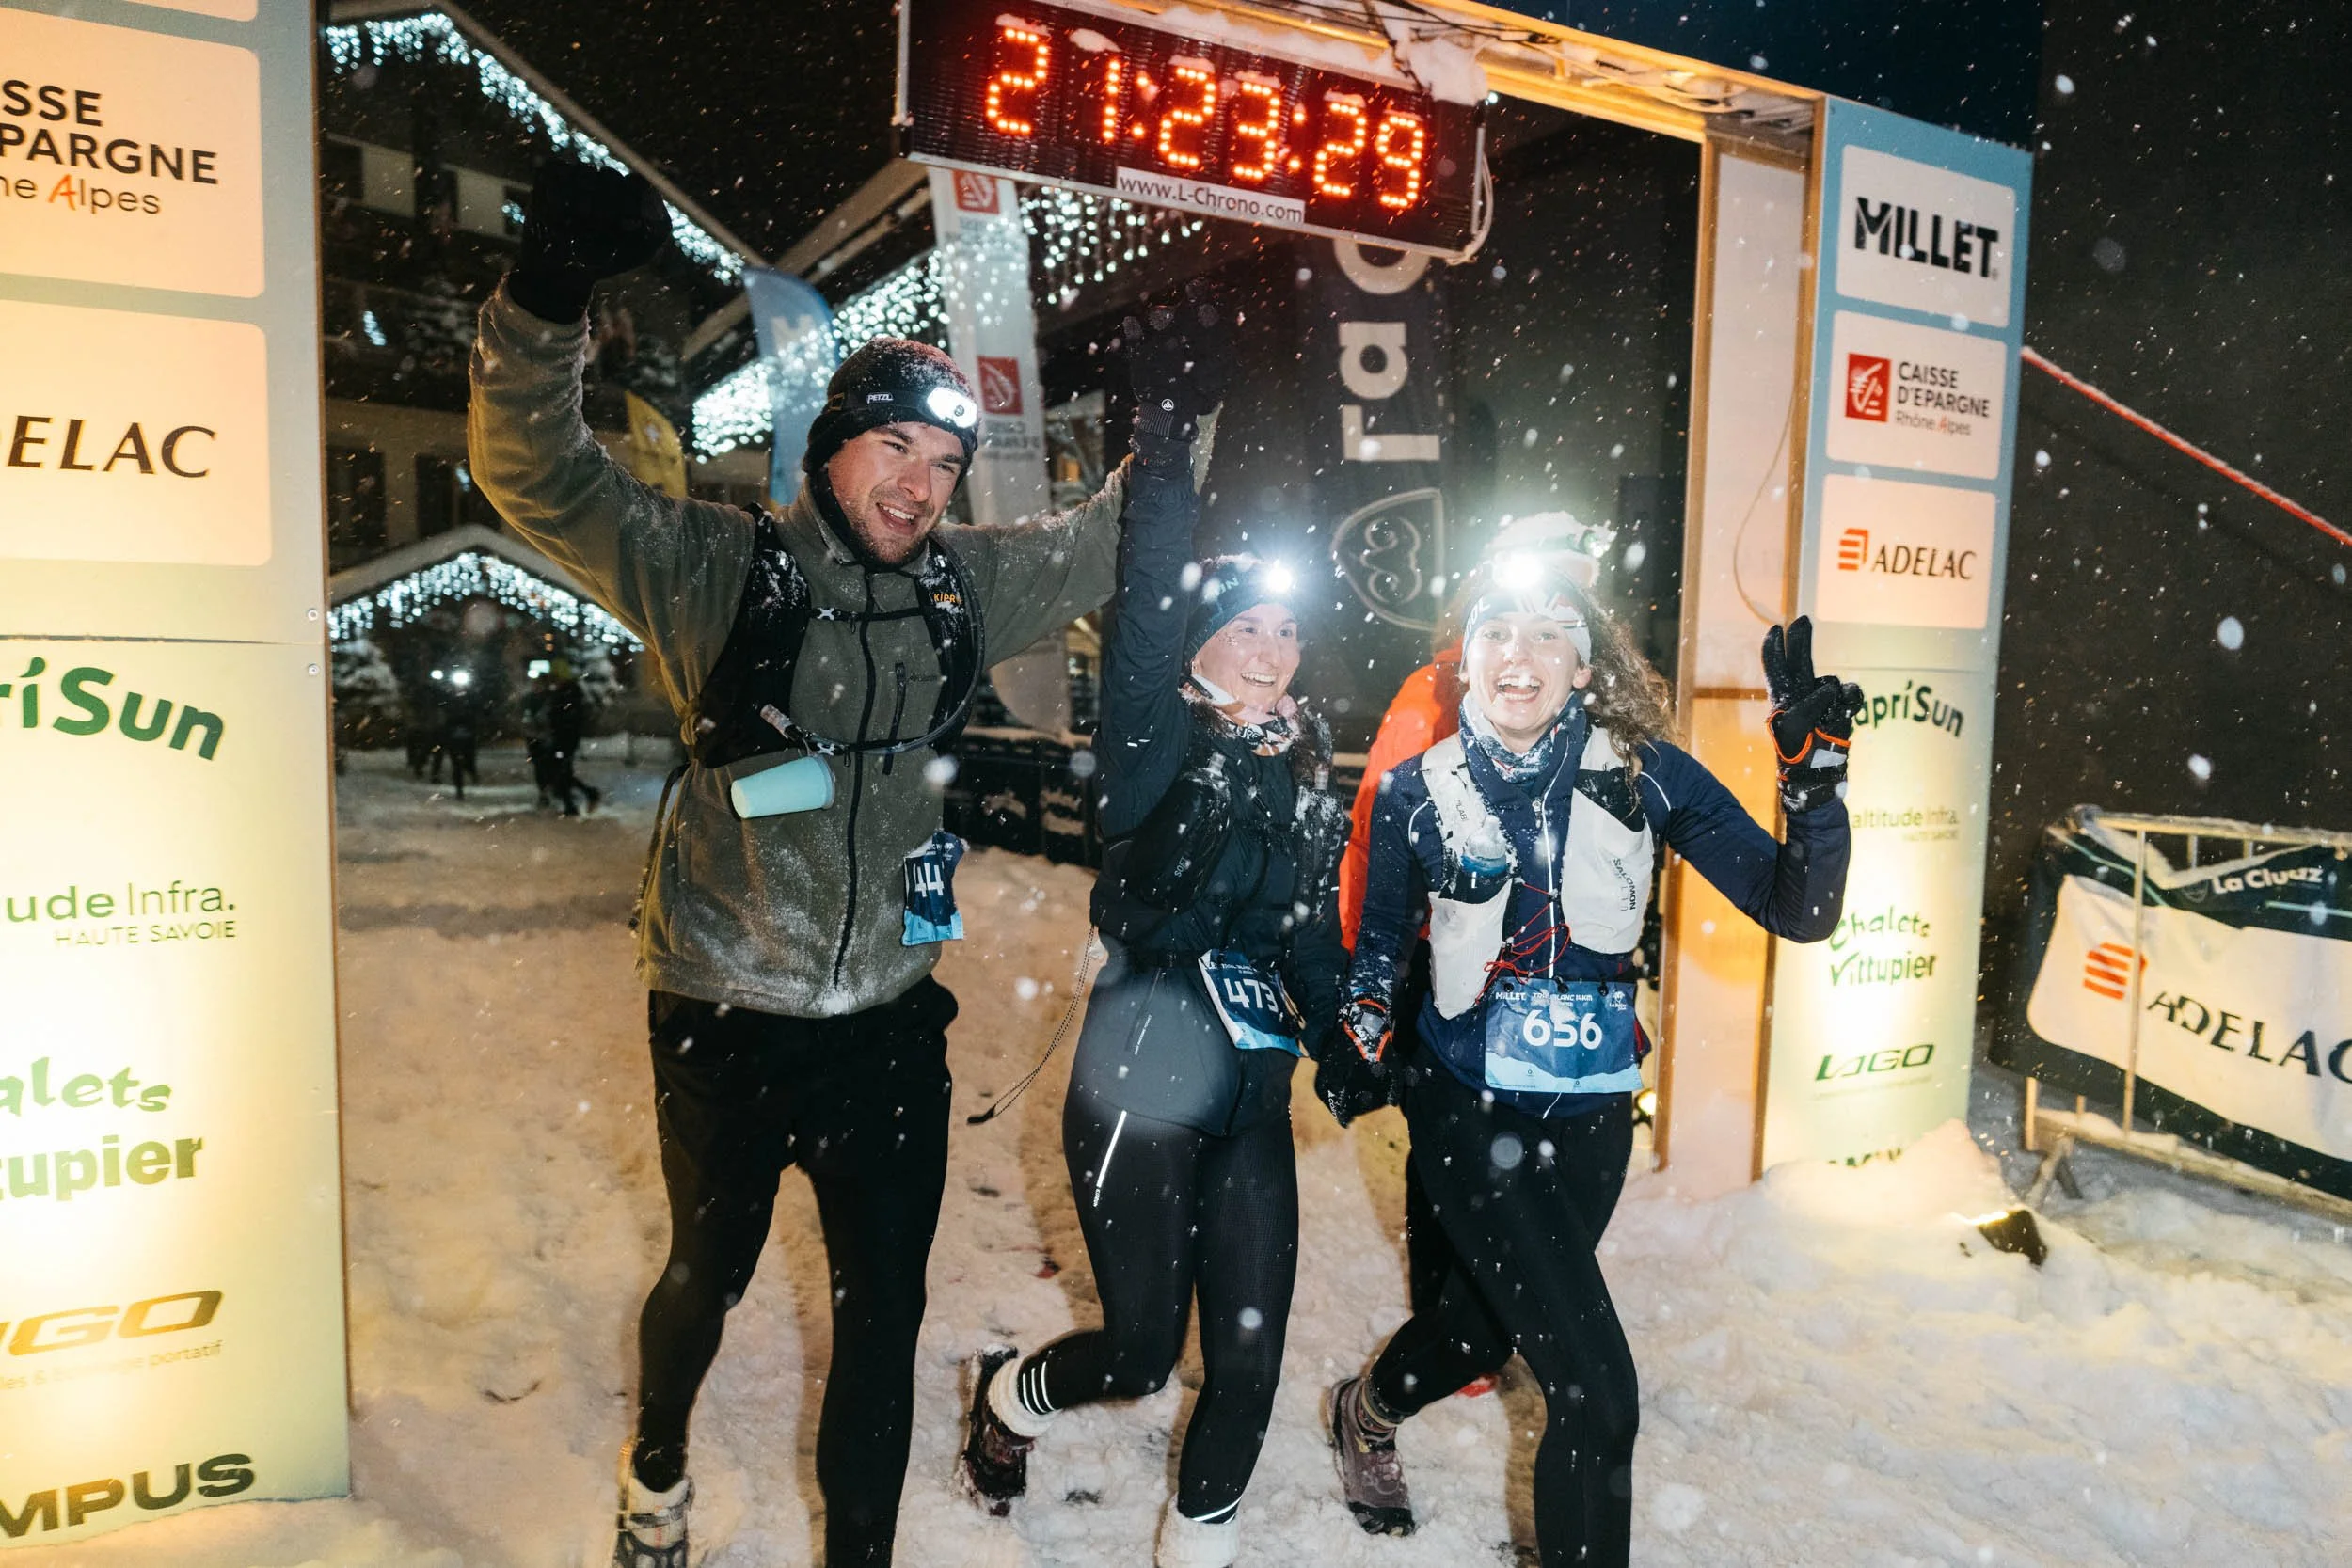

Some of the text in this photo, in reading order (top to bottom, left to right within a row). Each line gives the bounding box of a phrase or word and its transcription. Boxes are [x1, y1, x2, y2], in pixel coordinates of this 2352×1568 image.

[48, 174, 161, 214] Alpes
[1119, 176, 1303, 222] www.L-Chrono.com
[1854, 196, 1999, 277] MILLET
[1899, 361, 1959, 388] CAISSE
[866, 392, 894, 404] PETZL
[1897, 386, 1990, 418] D'EPARGNE
[8, 415, 215, 478] ELAC
[1870, 544, 1977, 579] ADELAC
[933, 593, 963, 605] KIPR
[1850, 680, 1964, 737] apriSun
[128, 880, 236, 916] Infra.
[1613, 858, 1636, 911] SALOMON
[2211, 876, 2245, 895] La
[54, 920, 236, 945] HAUTE SAVOIE
[1223, 977, 1279, 1013] 473
[1522, 1009, 1603, 1050] 656
[2147, 990, 2352, 1085] ADELAC
[0, 1134, 203, 1201] upier
[0, 1290, 224, 1356] GO
